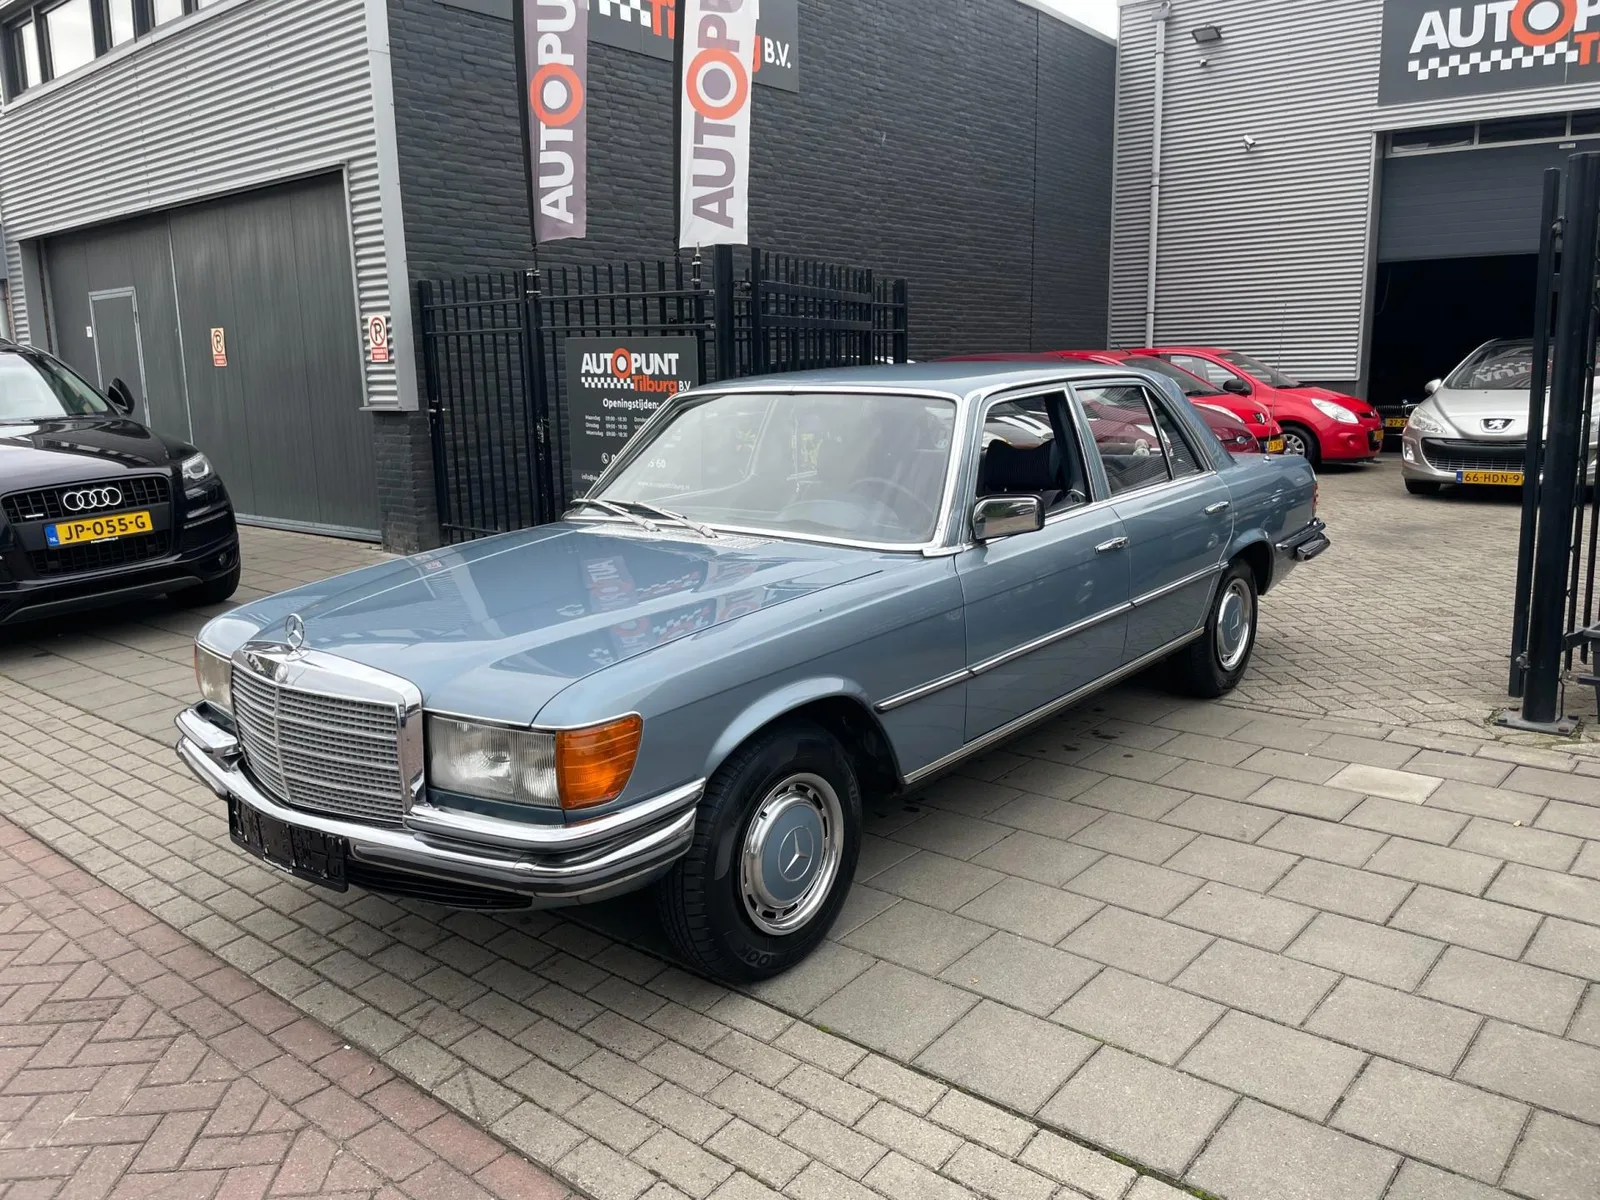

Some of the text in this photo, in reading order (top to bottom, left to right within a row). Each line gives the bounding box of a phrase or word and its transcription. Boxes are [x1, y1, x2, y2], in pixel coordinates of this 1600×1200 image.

[764, 37, 791, 68] B.V.
[581, 348, 679, 379] AUTOPUNT
[632, 375, 677, 396] Tilburg
[603, 398, 659, 411] Openingstijden:
[1465, 473, 1520, 484] 66-HDN-9
[65, 515, 146, 540] JP-055-G
